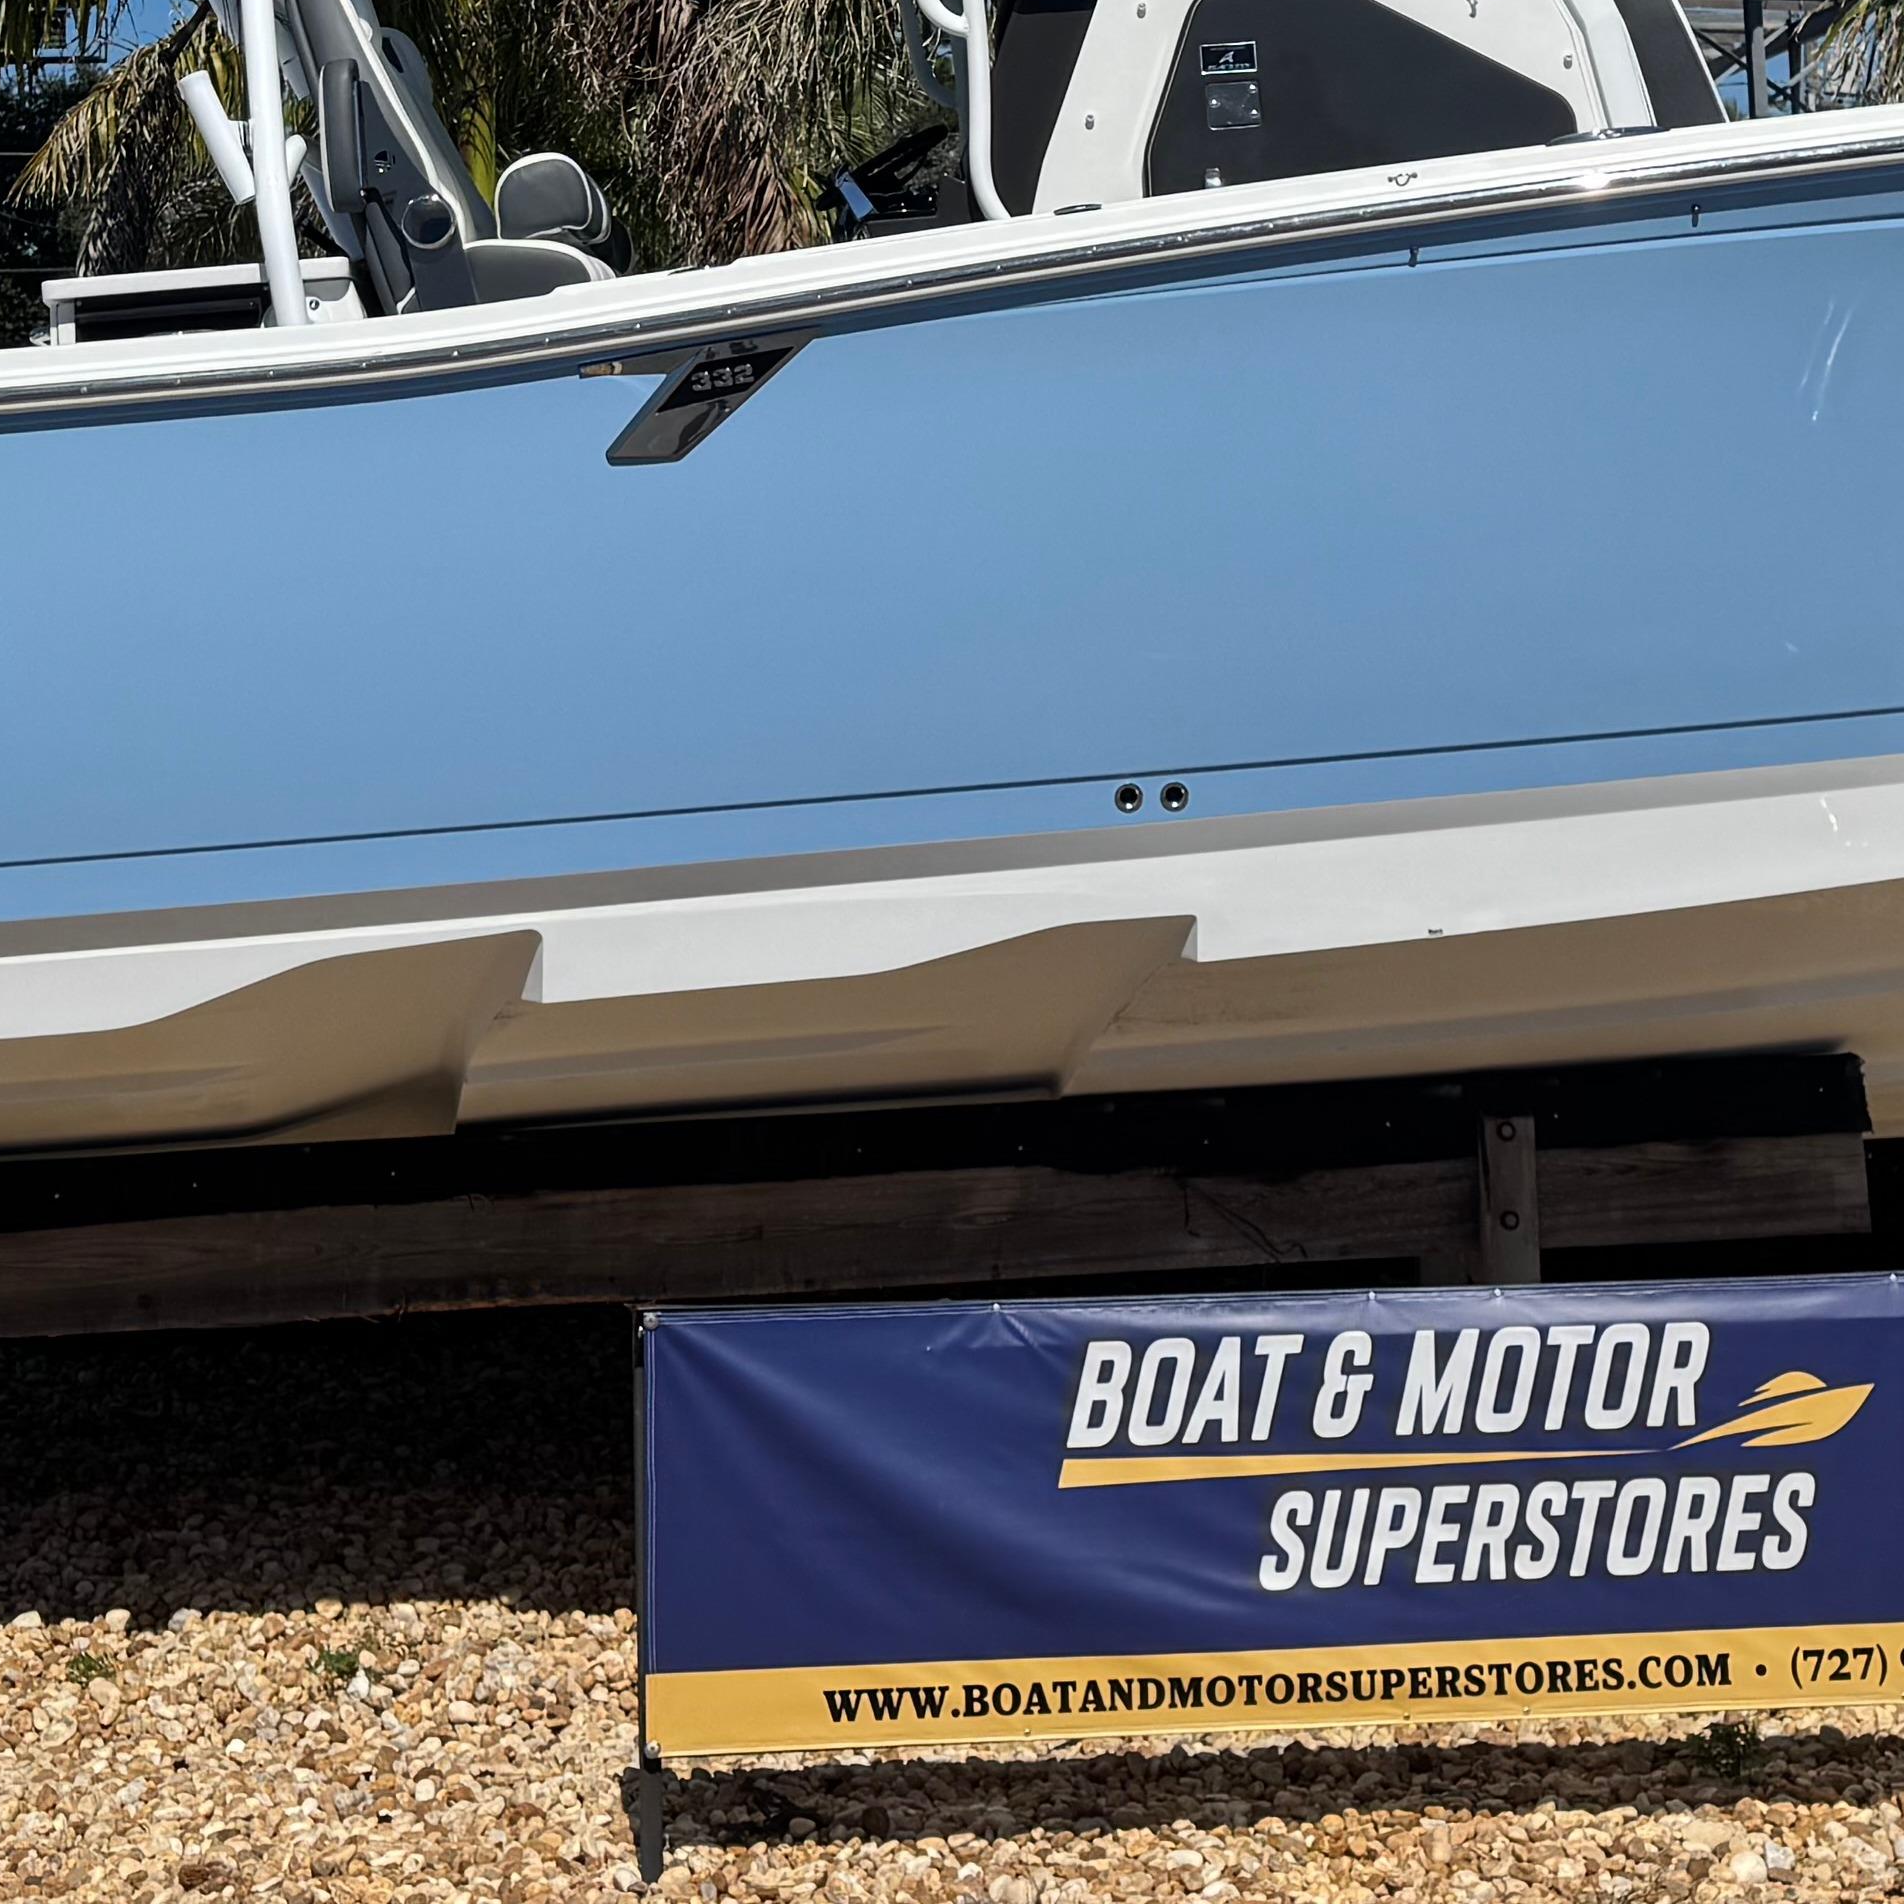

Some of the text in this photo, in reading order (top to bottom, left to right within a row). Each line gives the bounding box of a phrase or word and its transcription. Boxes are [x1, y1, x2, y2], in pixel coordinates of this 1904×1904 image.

[691, 362, 756, 393] 332
[1064, 1321, 1710, 1449] BOAT & MOTOR
[1258, 1471, 1817, 1592] SUPERSTORES
[823, 1652, 1732, 1723] WWW.BOATANDMOTORSUPERSTORES.COM
[1789, 1644, 1889, 1689] (727)
